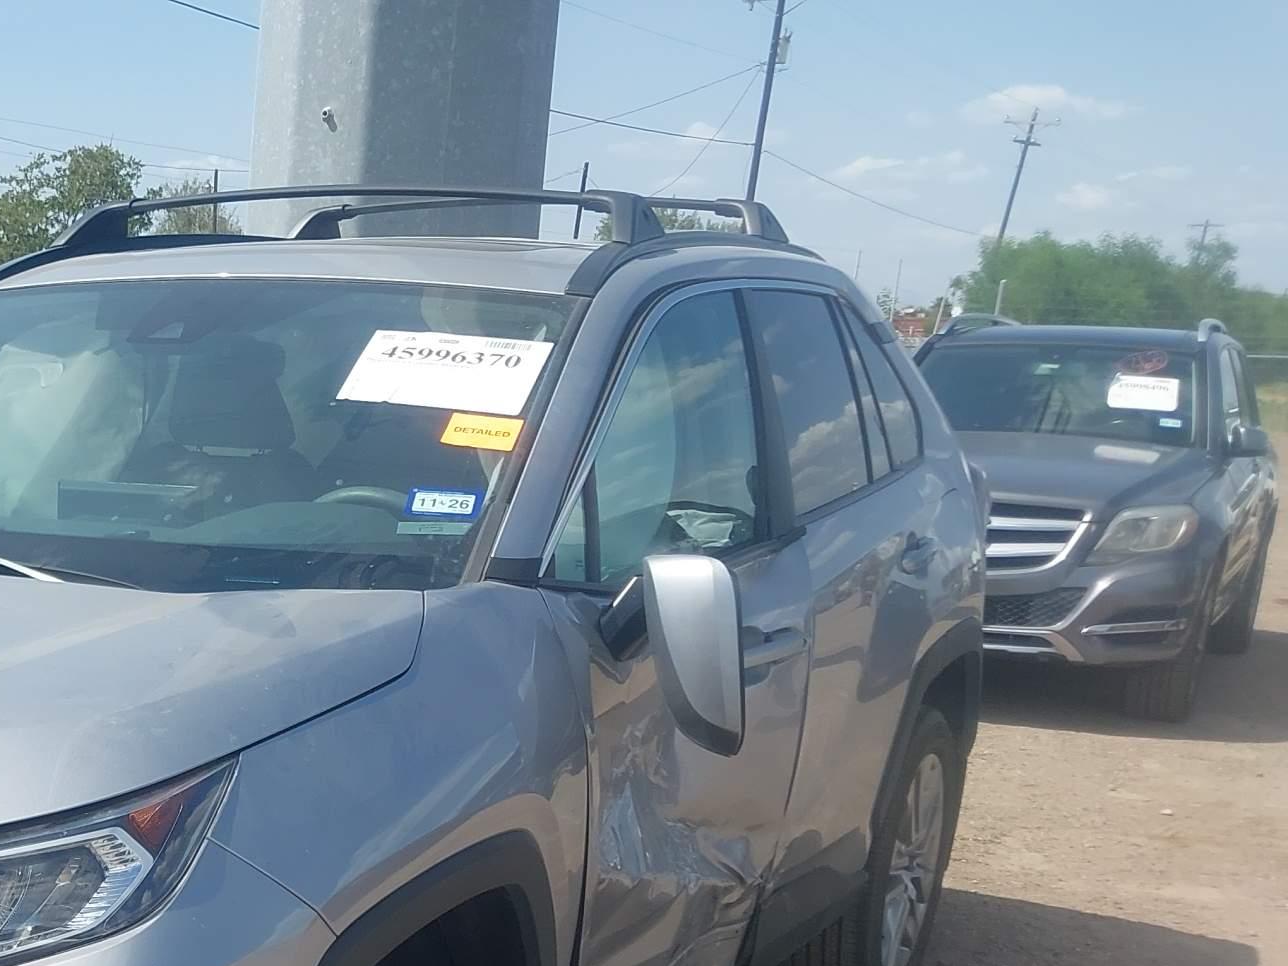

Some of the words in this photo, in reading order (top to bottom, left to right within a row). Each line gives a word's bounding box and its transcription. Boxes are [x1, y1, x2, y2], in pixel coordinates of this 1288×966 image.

[380, 344, 522, 369] 45996370
[453, 425, 511, 438] DETAILED
[447, 498, 471, 510] 26
